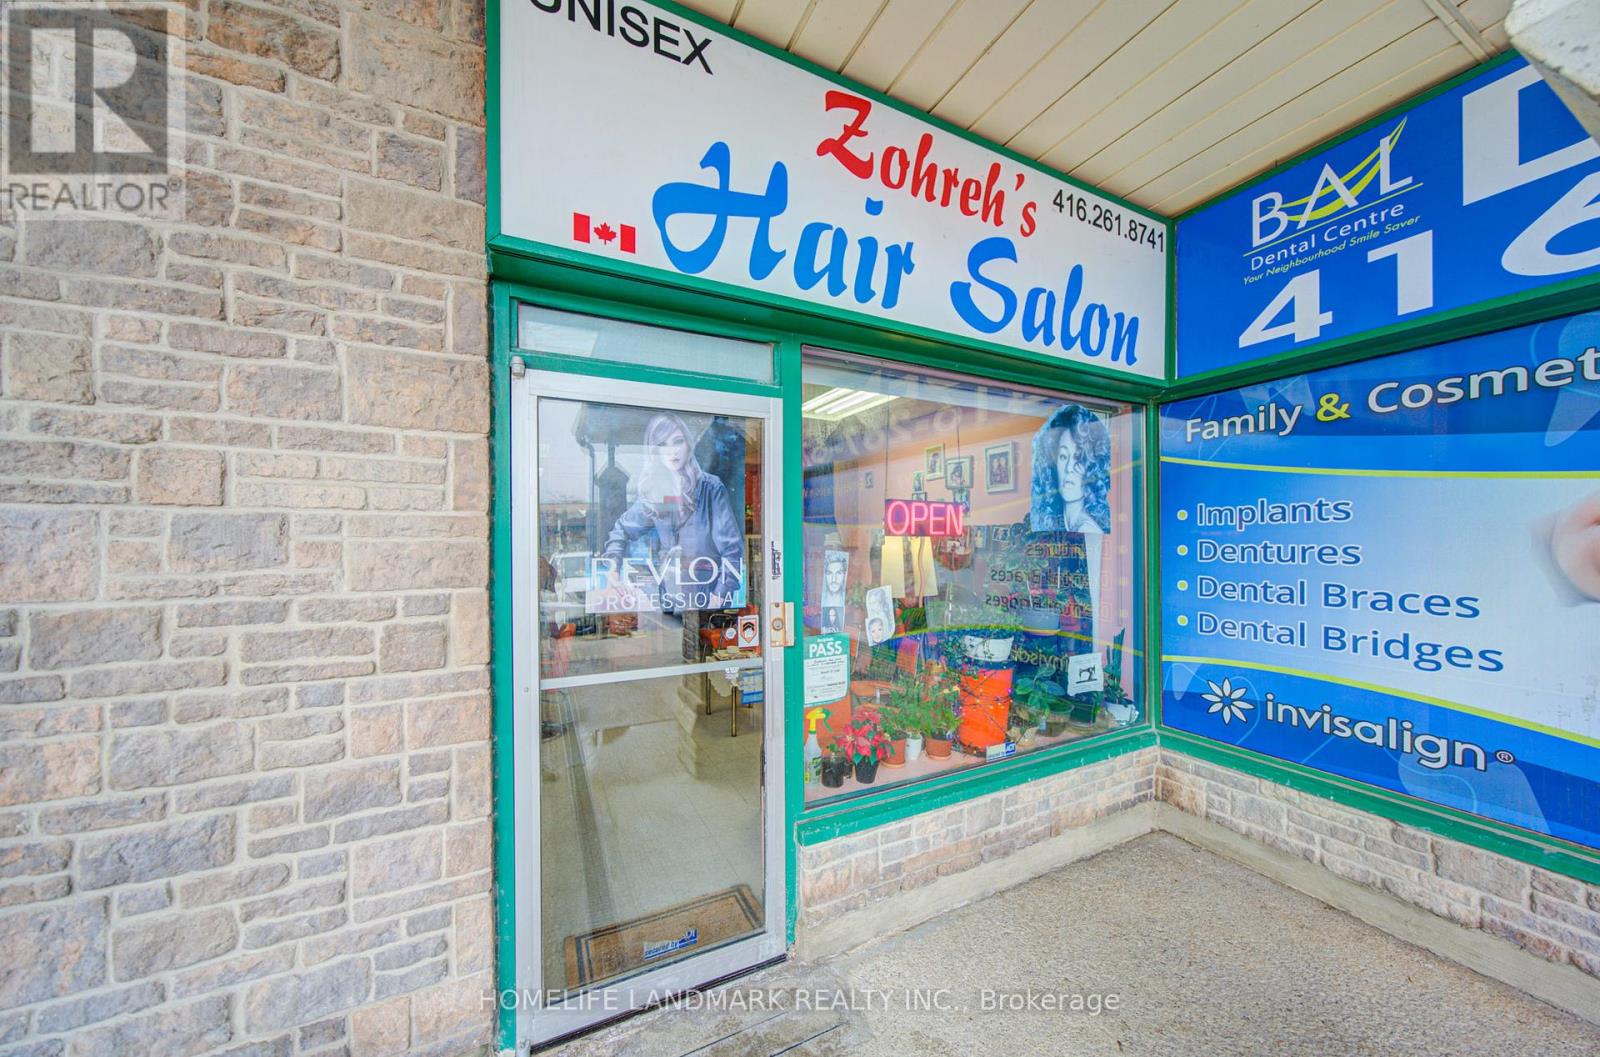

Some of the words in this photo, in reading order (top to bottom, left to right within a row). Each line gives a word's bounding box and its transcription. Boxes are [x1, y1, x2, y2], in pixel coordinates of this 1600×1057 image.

[816, 90, 1036, 238] Zohreh's
[1252, 136, 1413, 248] BAL
[1053, 189, 1164, 252] 416.261.8741
[1251, 234, 1316, 271] Dental
[1324, 204, 1405, 242] Centre
[651, 141, 916, 310] Hair
[950, 236, 1140, 366] Salon
[1243, 272, 1265, 286] Your
[1266, 241, 1347, 277] Neighbourhood
[1349, 230, 1381, 247] Smile
[1384, 215, 1421, 235] Saver
[1185, 402, 1302, 442] Family
[1316, 392, 1351, 422] &
[886, 500, 963, 536] OPEN
[1196, 498, 1353, 531] Implants
[590, 556, 744, 586] REVLON
[1196, 539, 1362, 566] Dentures
[1196, 576, 1307, 607] Dental
[1322, 582, 1481, 619] Braces
[809, 641, 843, 658] PASS
[1196, 612, 1307, 648] Dental
[1322, 626, 1505, 672] Bridges
